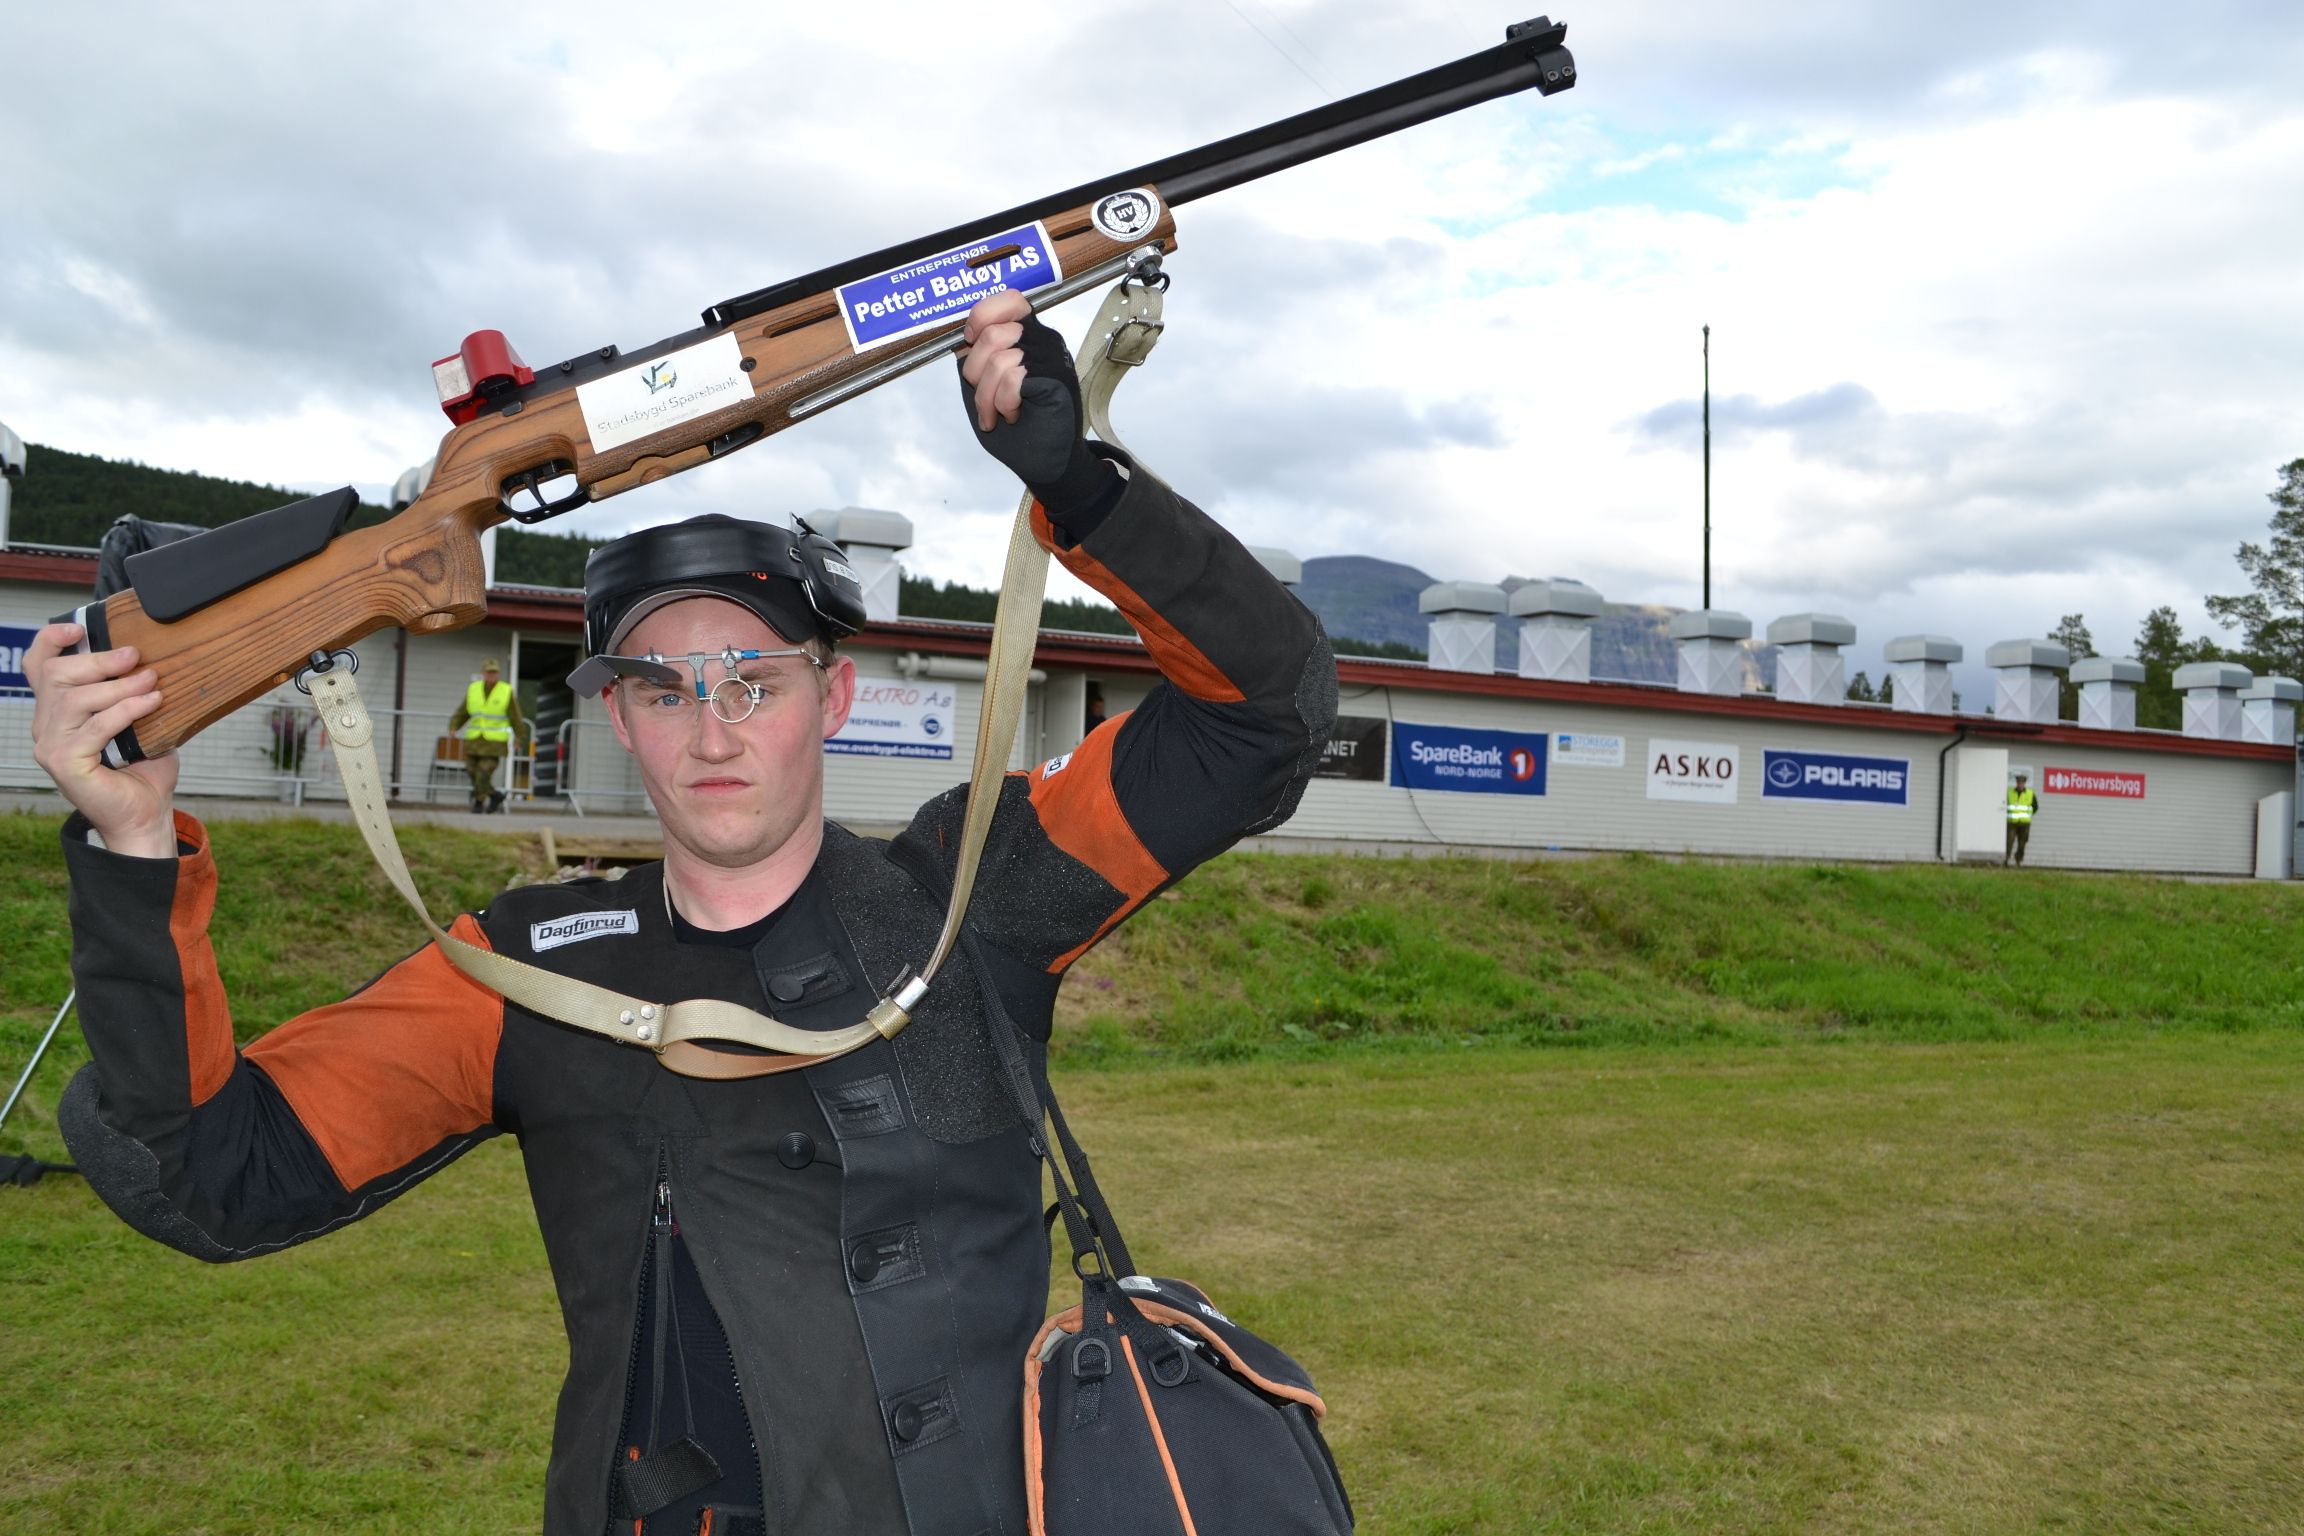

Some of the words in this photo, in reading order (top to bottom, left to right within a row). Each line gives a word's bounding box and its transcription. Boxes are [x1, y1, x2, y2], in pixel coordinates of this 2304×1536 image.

[1116, 206, 1134, 220] HV
[890, 244, 991, 285] ENTREPRENØR
[854, 285, 926, 323] Petter
[930, 262, 1002, 298] Bakøy
[1009, 246, 1040, 273] AS
[908, 283, 1008, 321] www.bakoy.no
[598, 400, 667, 434] Stadsbygd
[669, 376, 738, 409] Sparebank
[853, 686, 920, 706] LEKTRO
[1324, 740, 1358, 757] NET
[1411, 741, 1503, 766] SpareBank
[1434, 765, 1502, 779] NORD-NORGE
[1654, 753, 1732, 779] ASKO
[1804, 765, 1903, 790] POLARIS
[2070, 773, 2141, 796] Forsvarsbygg
[539, 915, 626, 940] Dagfinrud
